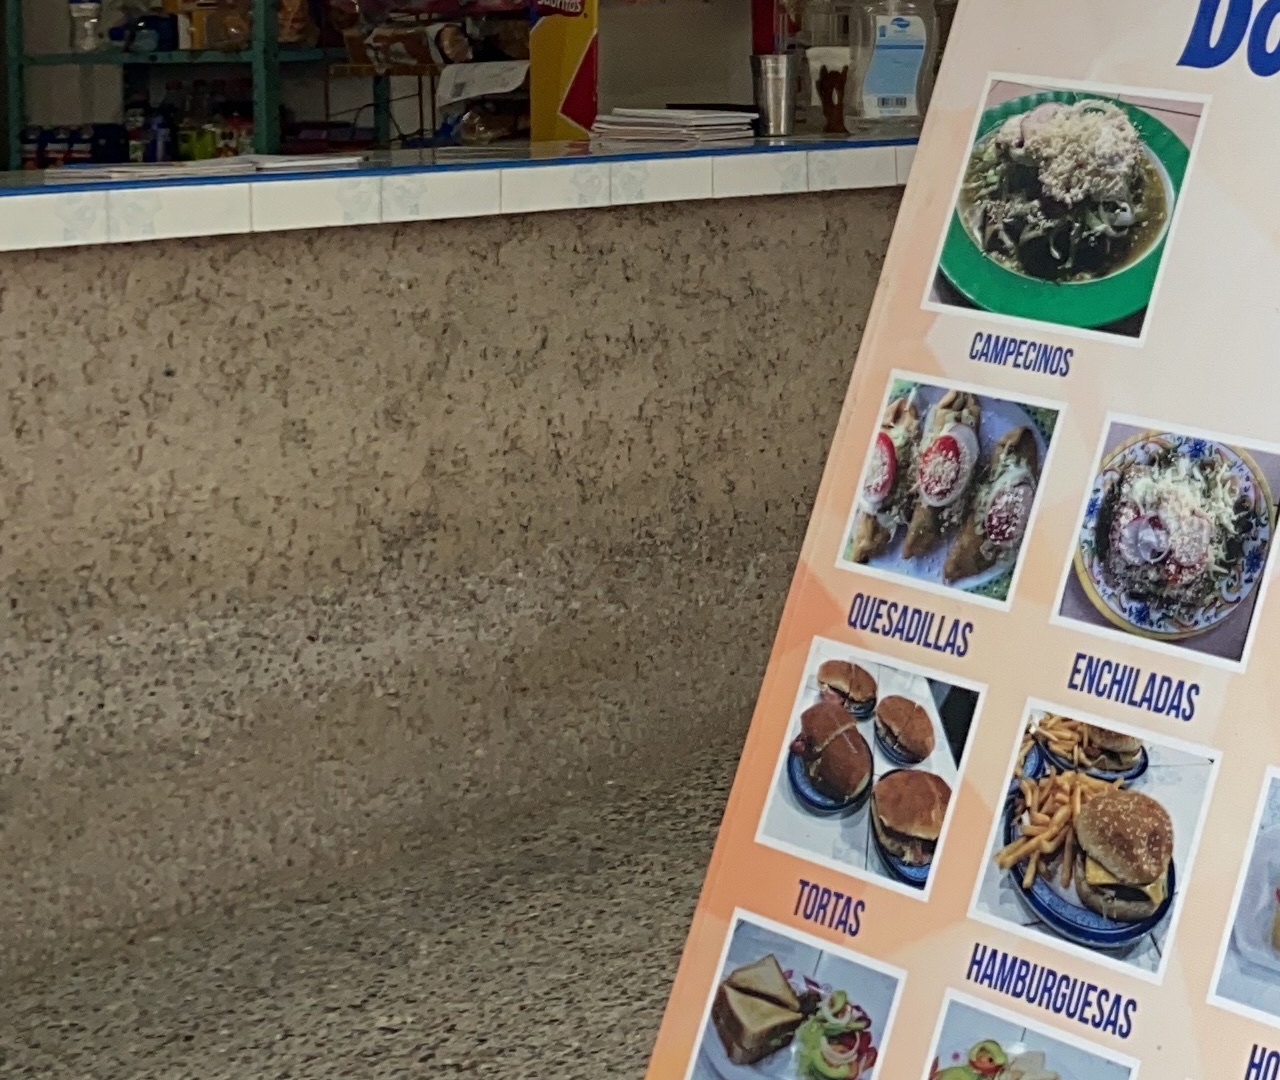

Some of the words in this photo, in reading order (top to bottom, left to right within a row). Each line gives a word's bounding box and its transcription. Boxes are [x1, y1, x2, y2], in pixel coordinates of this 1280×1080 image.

[968, 331, 1074, 378] CAMPECINOS
[848, 592, 975, 659] QUESADILLAS
[1067, 652, 1200, 721] ENCHILADAS
[793, 878, 866, 938] TORTAS
[966, 943, 1138, 1039] HAMBURGUESAS
